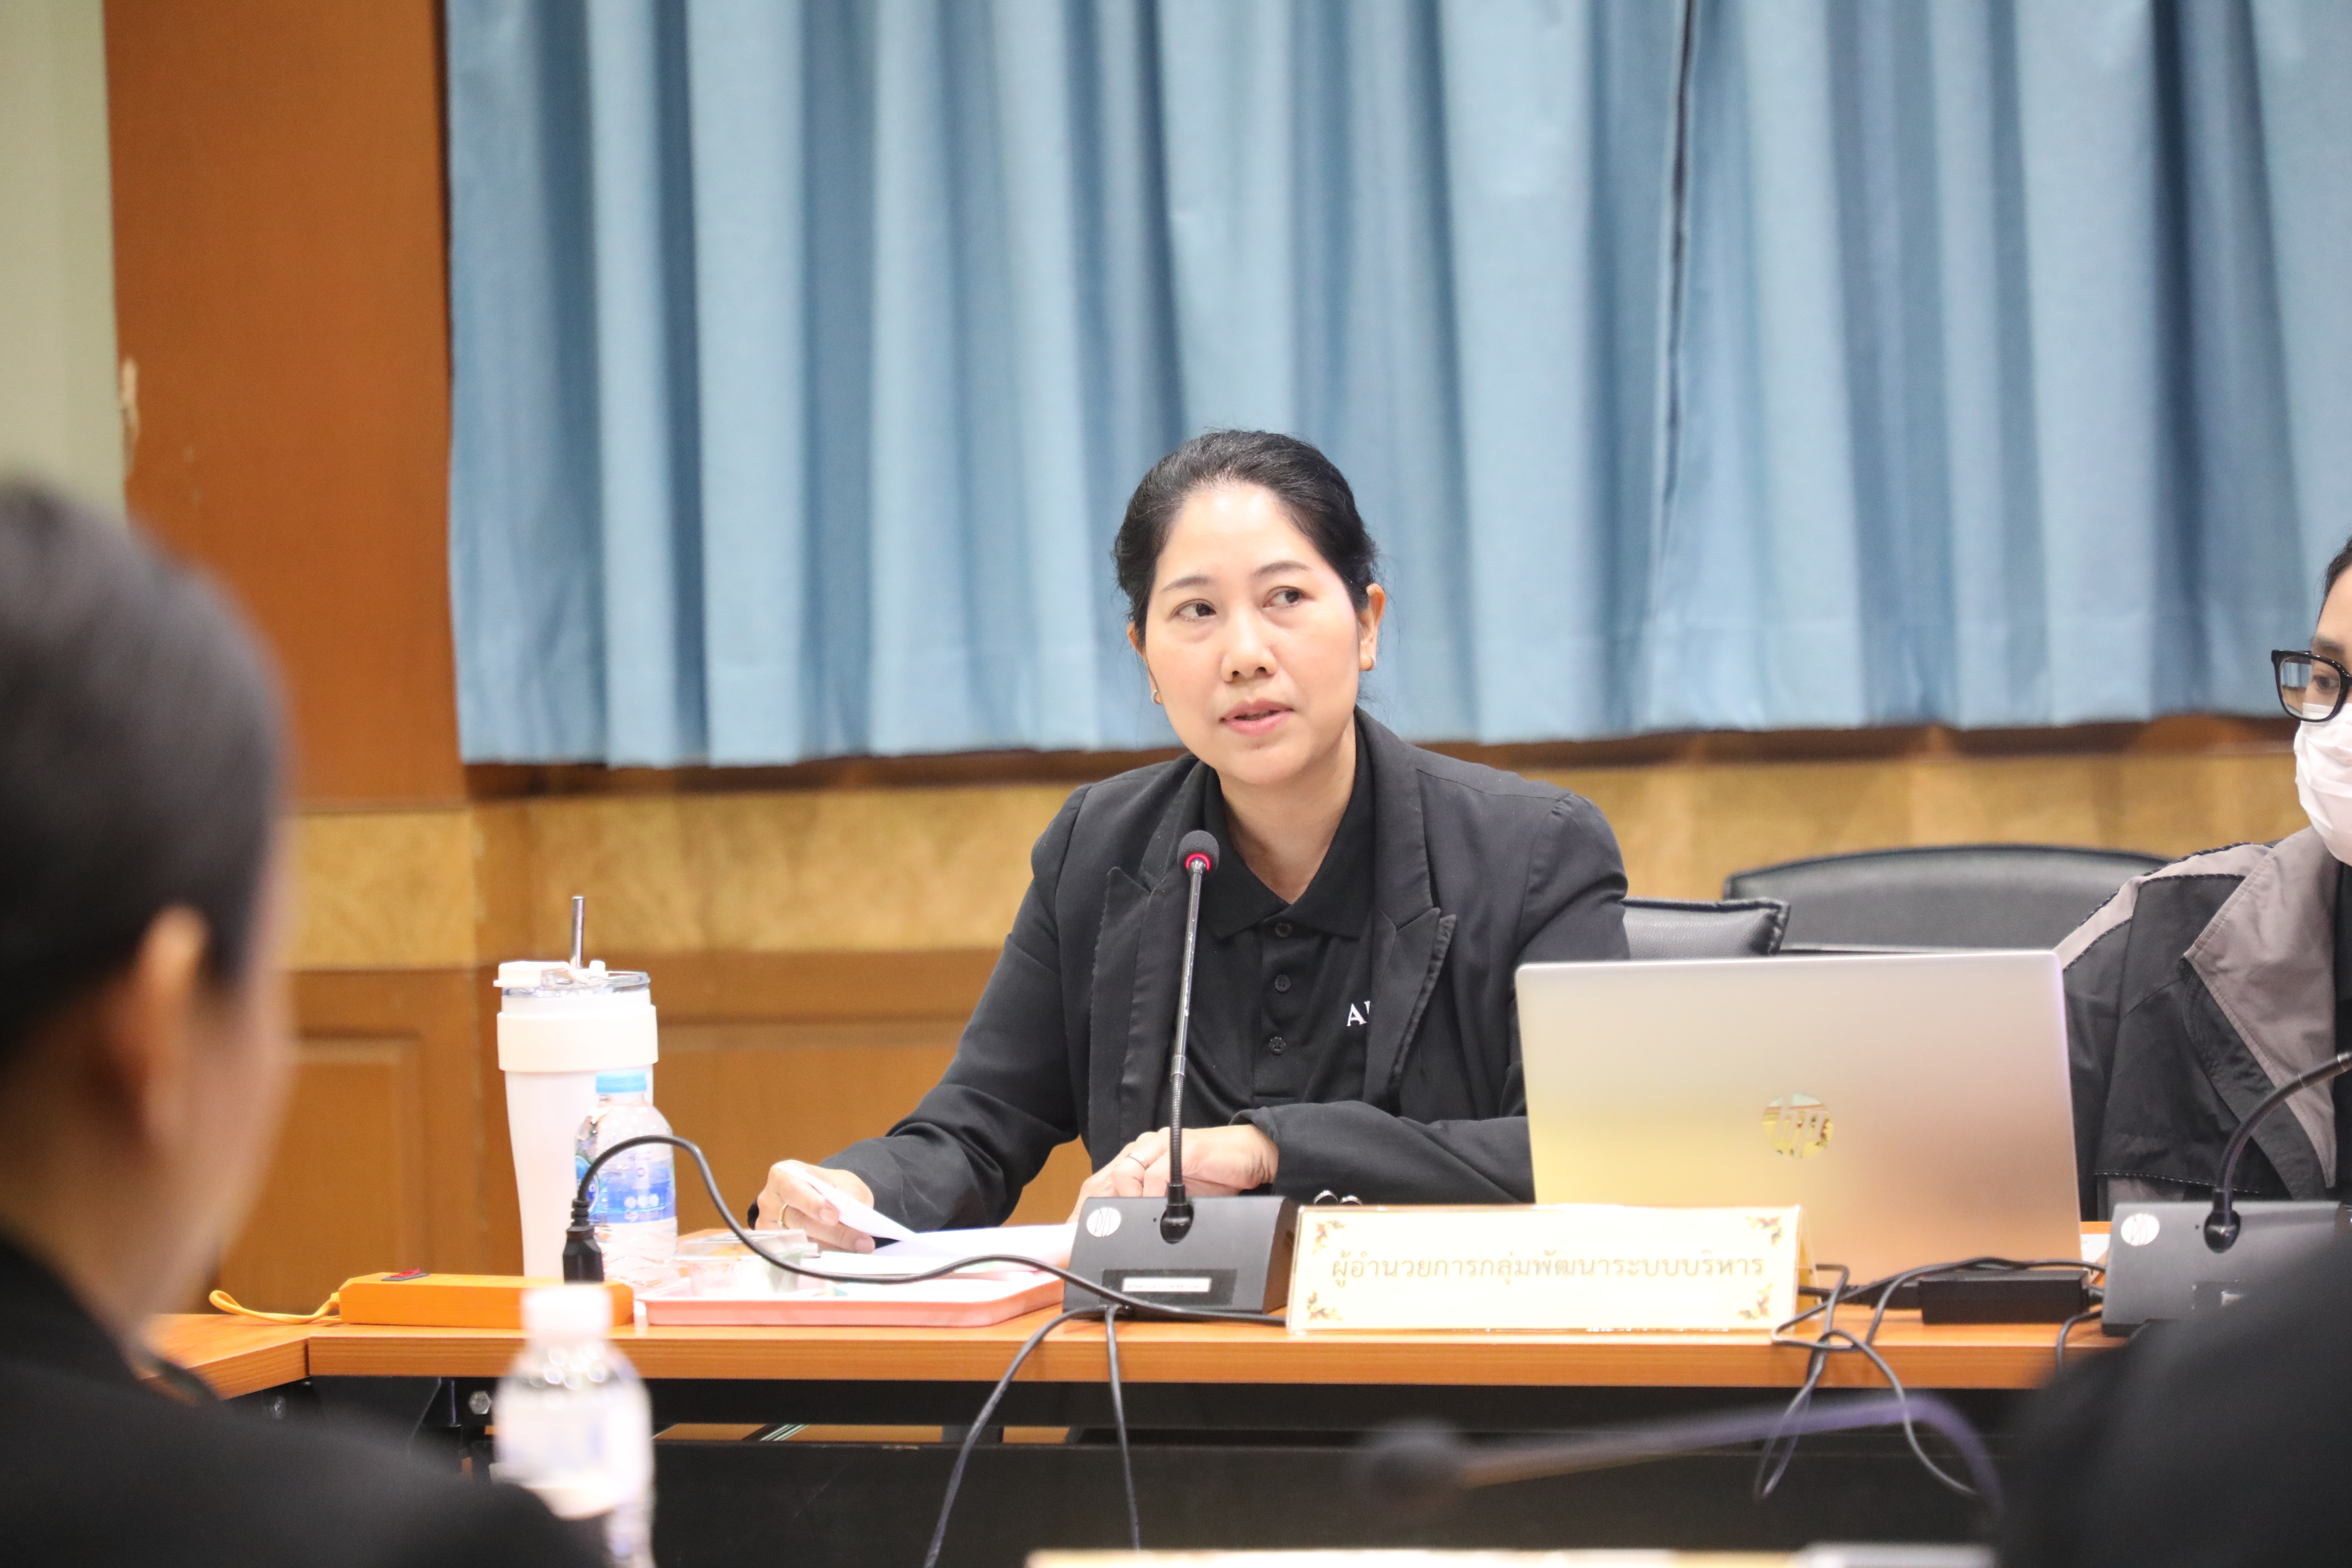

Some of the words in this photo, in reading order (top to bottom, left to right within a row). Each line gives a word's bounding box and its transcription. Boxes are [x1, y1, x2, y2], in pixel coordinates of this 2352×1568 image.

[1771, 1094, 1829, 1159] hp
[1331, 1249, 1764, 1288] ผู้อำนวยการกลุ่มพัฒนาระบบบริหาร
